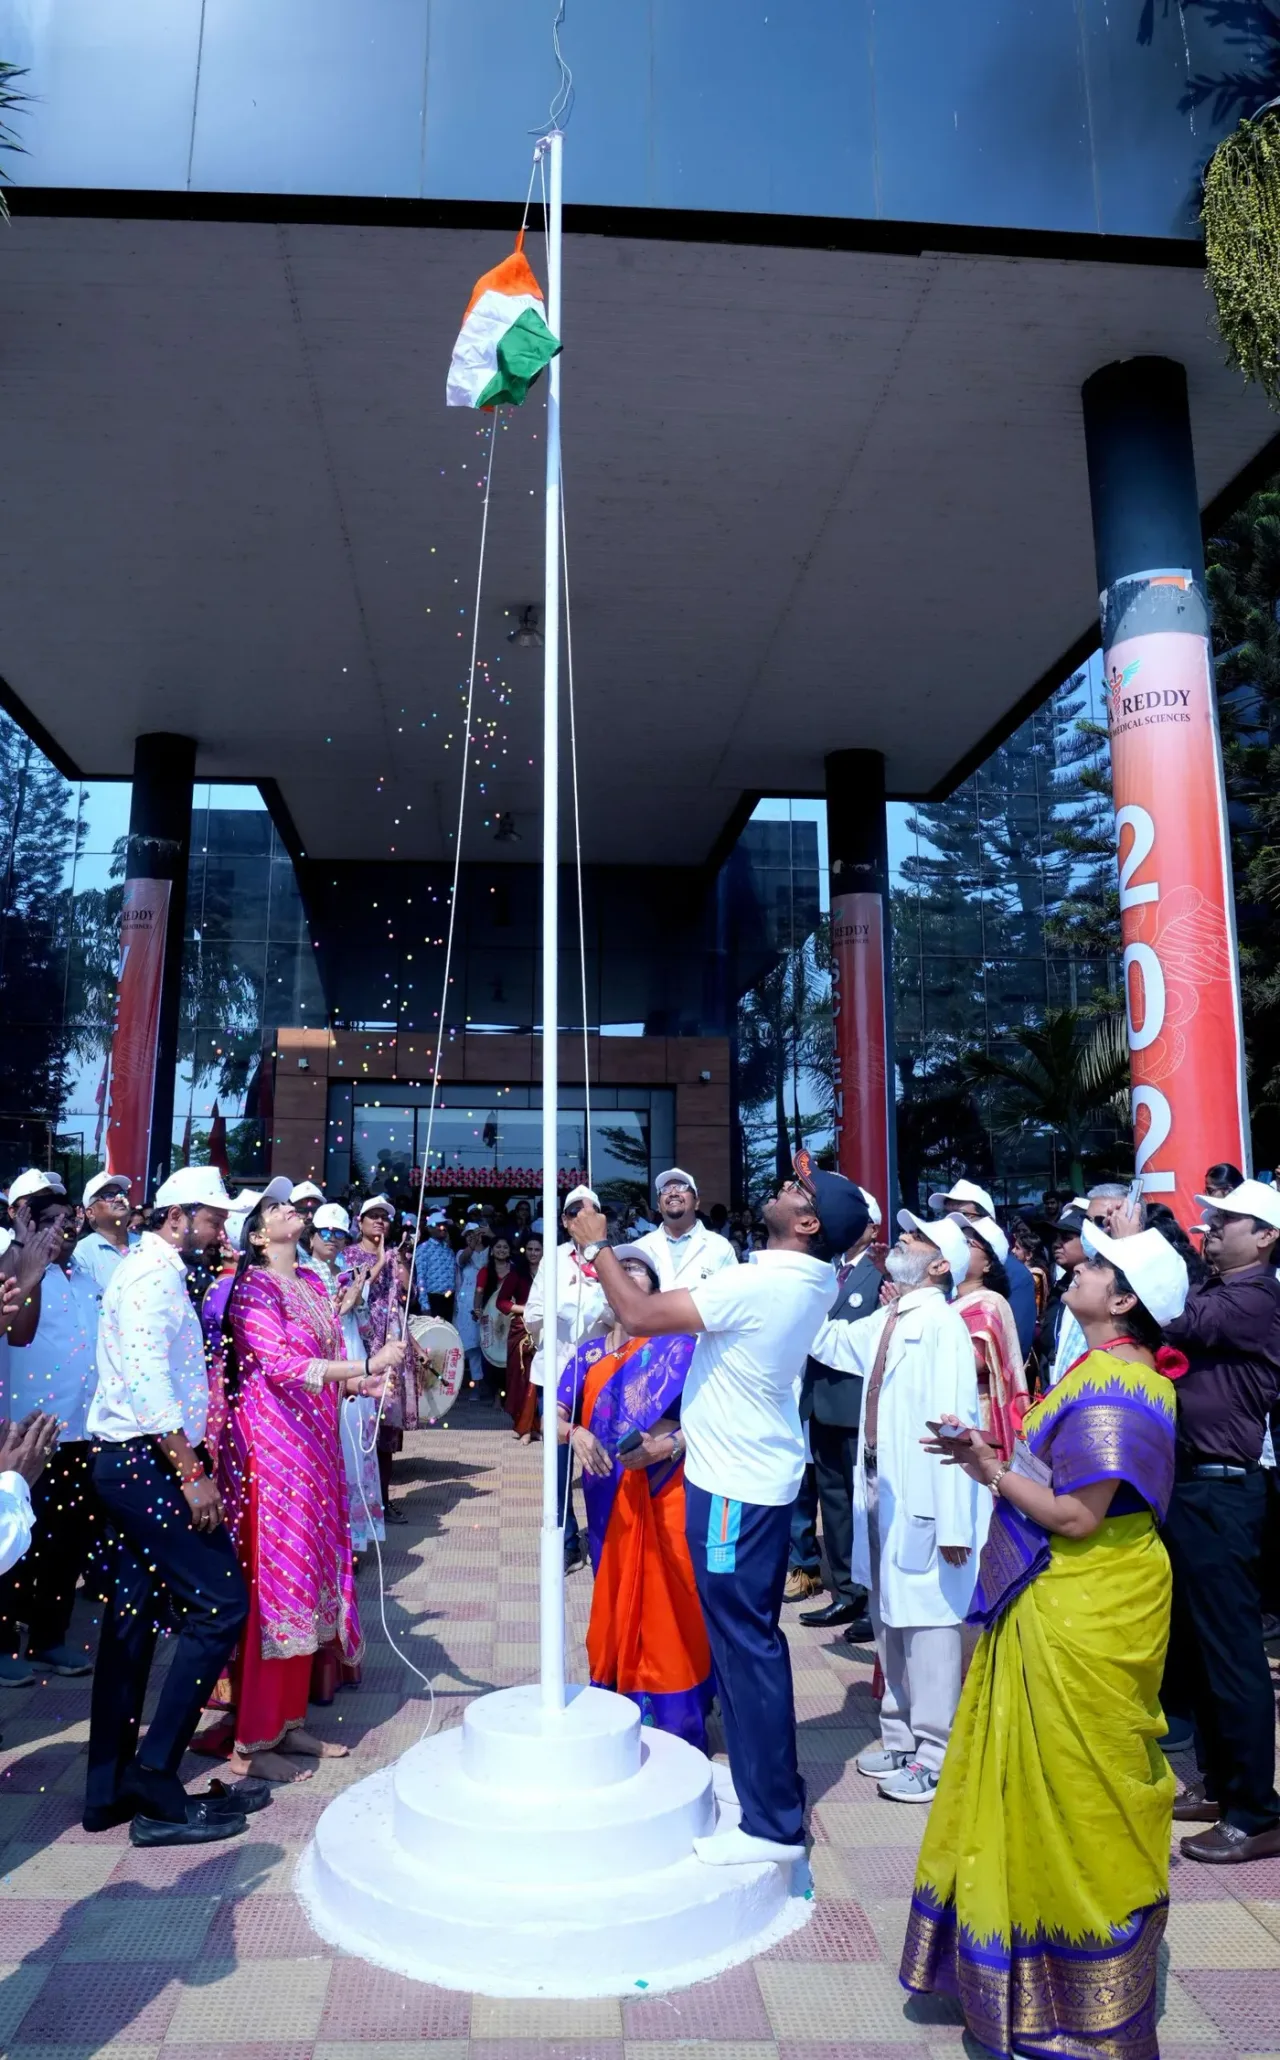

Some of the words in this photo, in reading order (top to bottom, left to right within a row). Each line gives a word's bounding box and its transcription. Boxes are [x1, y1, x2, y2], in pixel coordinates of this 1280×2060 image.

[1122, 689, 1191, 716] REDDY
[1113, 717, 1143, 737] MEDICAL
[1144, 713, 1191, 725] SCIENCES
